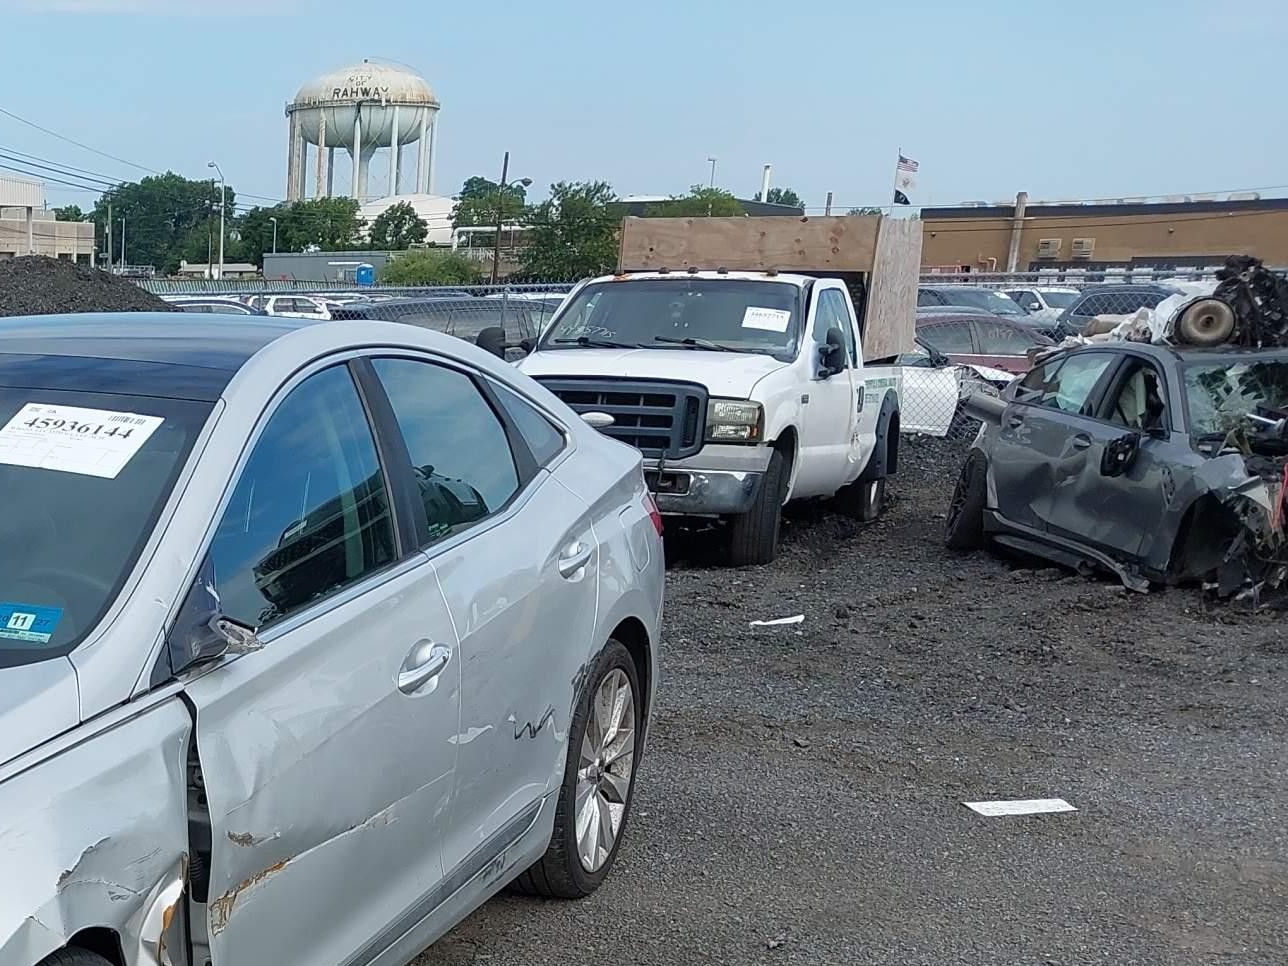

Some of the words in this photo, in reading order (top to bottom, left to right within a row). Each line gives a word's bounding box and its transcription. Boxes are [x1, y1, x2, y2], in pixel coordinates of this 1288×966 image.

[332, 87, 389, 99] RAHWAY
[23, 415, 135, 440] 45936144
[12, 614, 29, 627] 11
